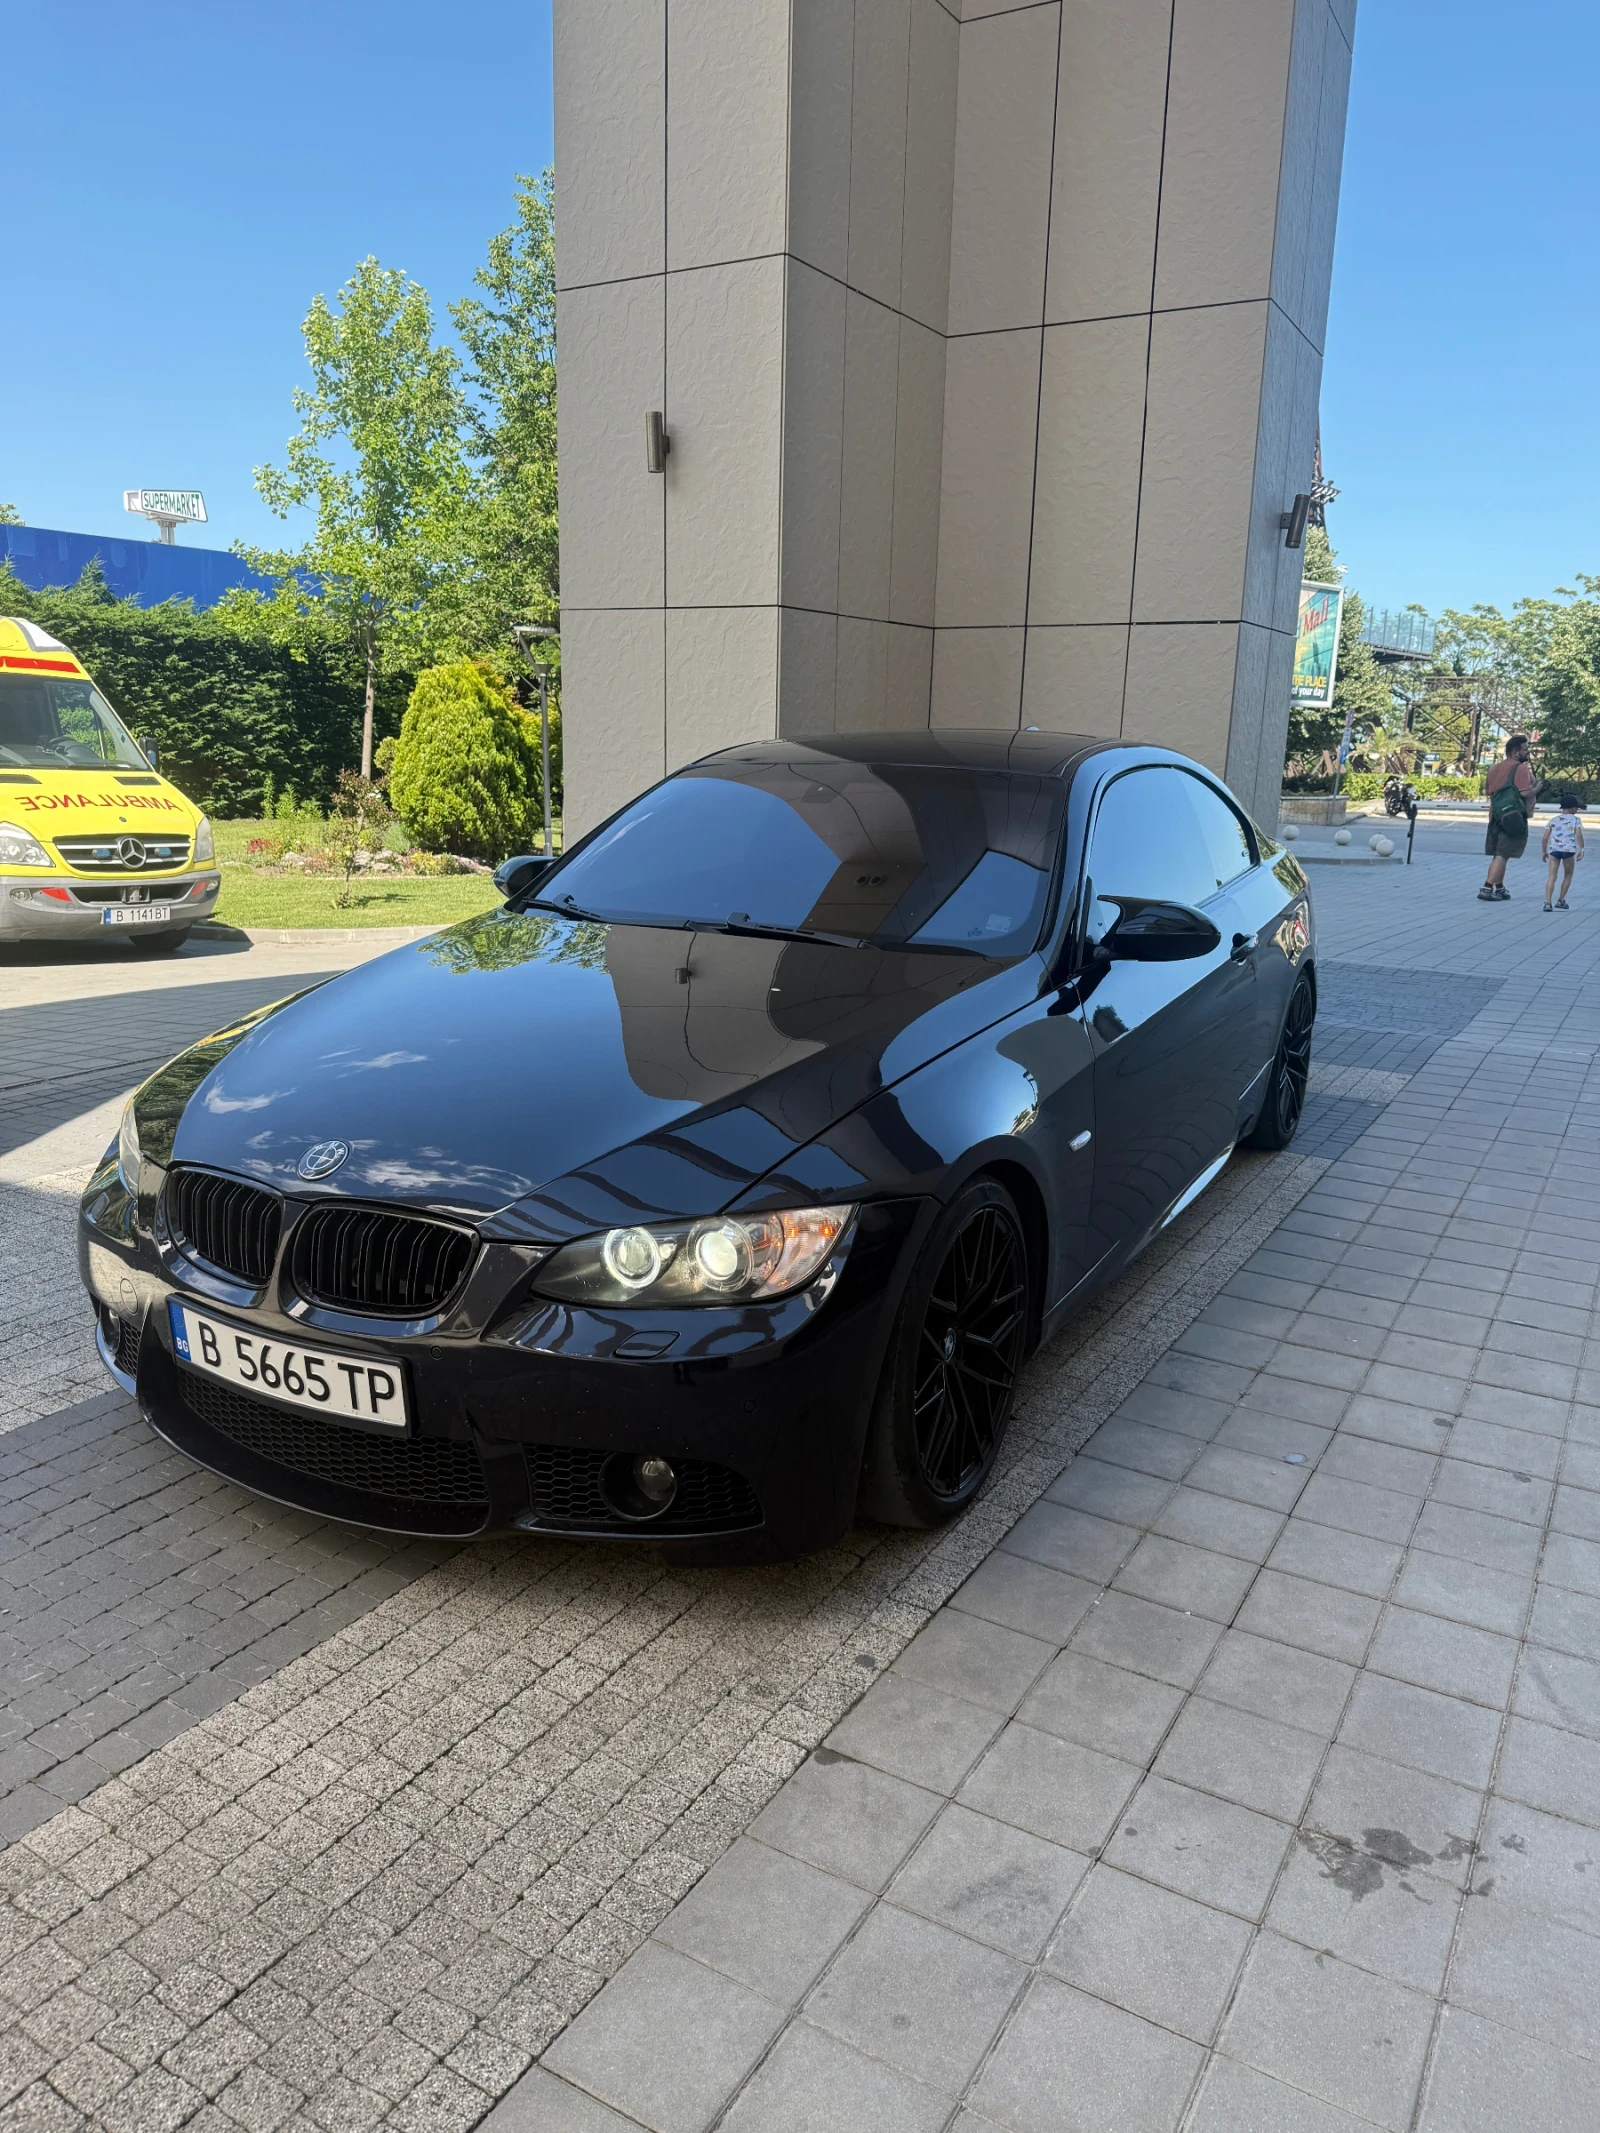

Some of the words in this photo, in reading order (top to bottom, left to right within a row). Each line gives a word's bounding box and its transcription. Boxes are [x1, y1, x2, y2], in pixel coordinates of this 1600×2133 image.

[143, 493, 200, 519] SUPERMARKET
[1303, 595, 1330, 636] Mall
[1305, 675, 1327, 688] PLACE
[1299, 687, 1313, 697] your
[1313, 687, 1325, 699] day
[116, 911, 124, 922] B
[176, 1336, 189, 1353] BG
[198, 1320, 221, 1368] B
[235, 1335, 330, 1402] 5665
[337, 1362, 395, 1414] TP
